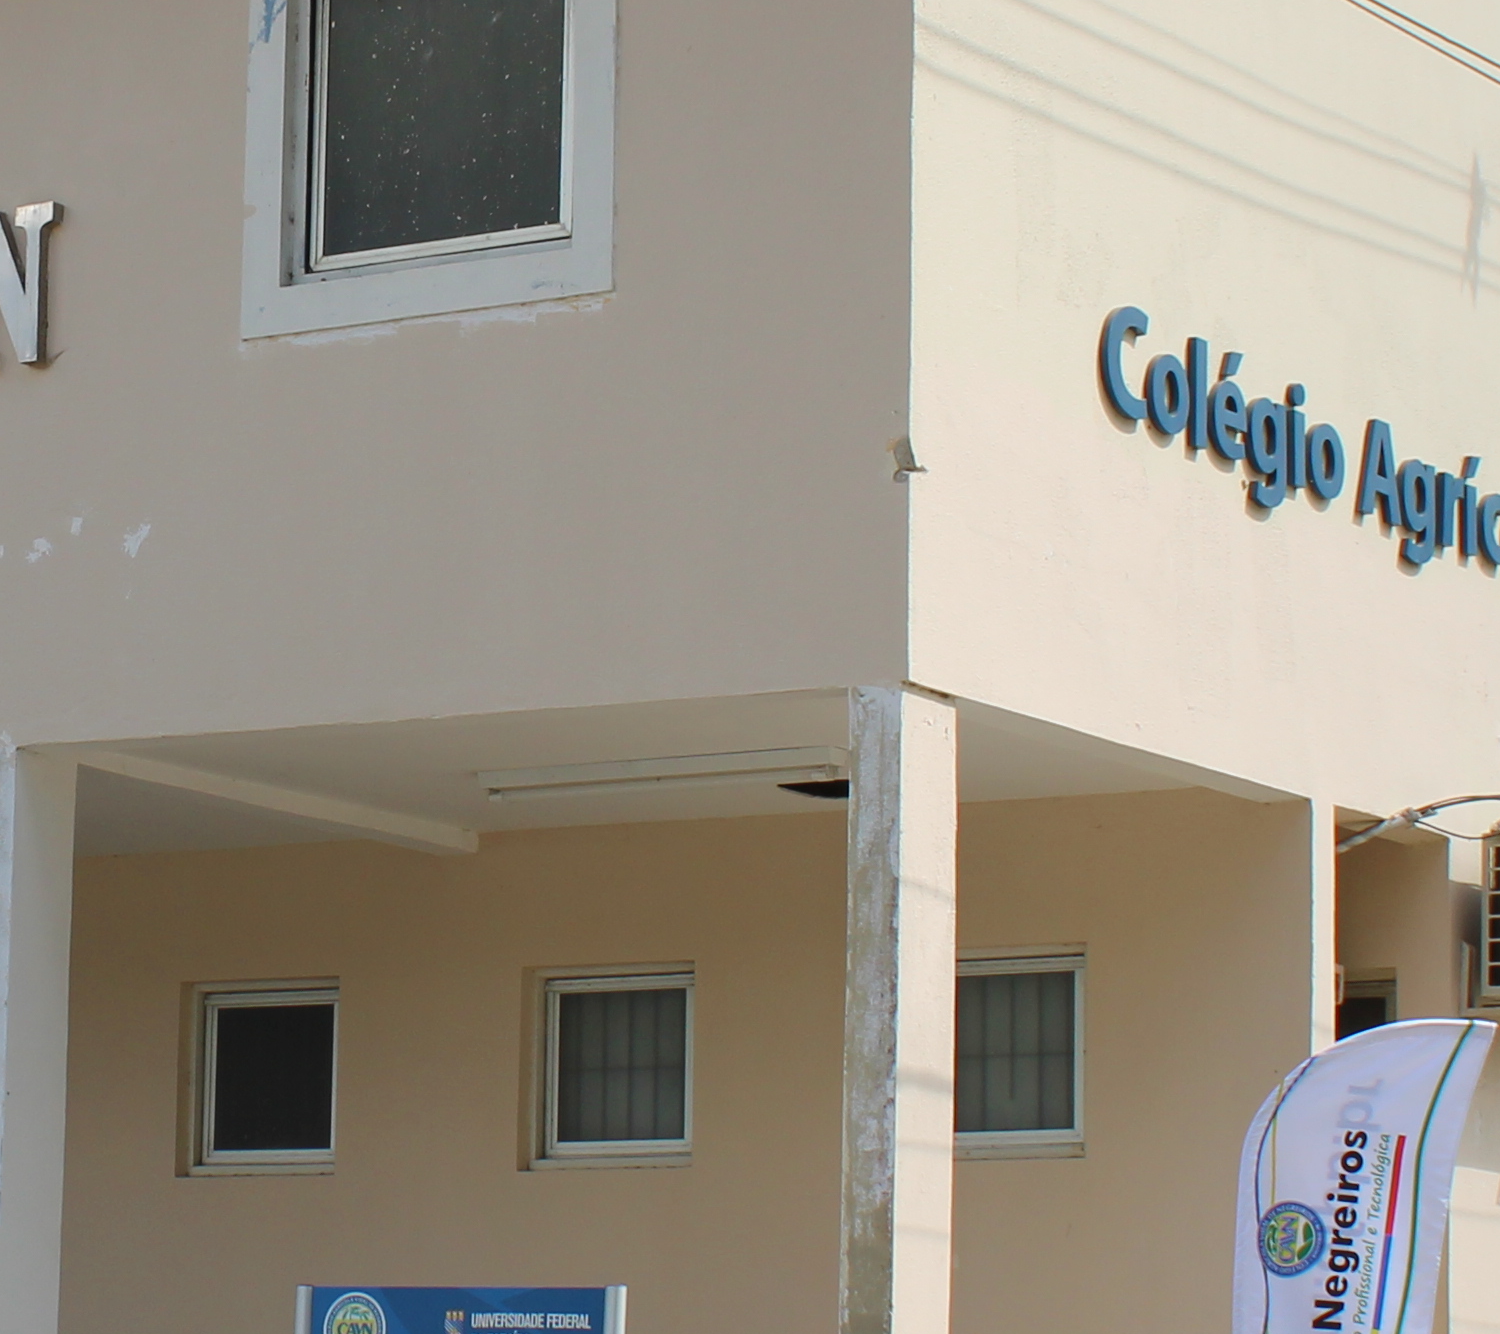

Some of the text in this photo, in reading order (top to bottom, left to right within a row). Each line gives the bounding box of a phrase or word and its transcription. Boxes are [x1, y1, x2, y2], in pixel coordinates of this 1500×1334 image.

[1099, 305, 1345, 509] Colégio
[1367, 1133, 1391, 1220] Tecnológica
[1279, 1216, 1299, 1262] CAVN
[1312, 1130, 1368, 1331] Negreiros
[1367, 1227, 1377, 1236] e
[471, 1313, 591, 1330] UNIVERSIDADE FEDERAL
[1353, 1239, 1375, 1326] Profissional
